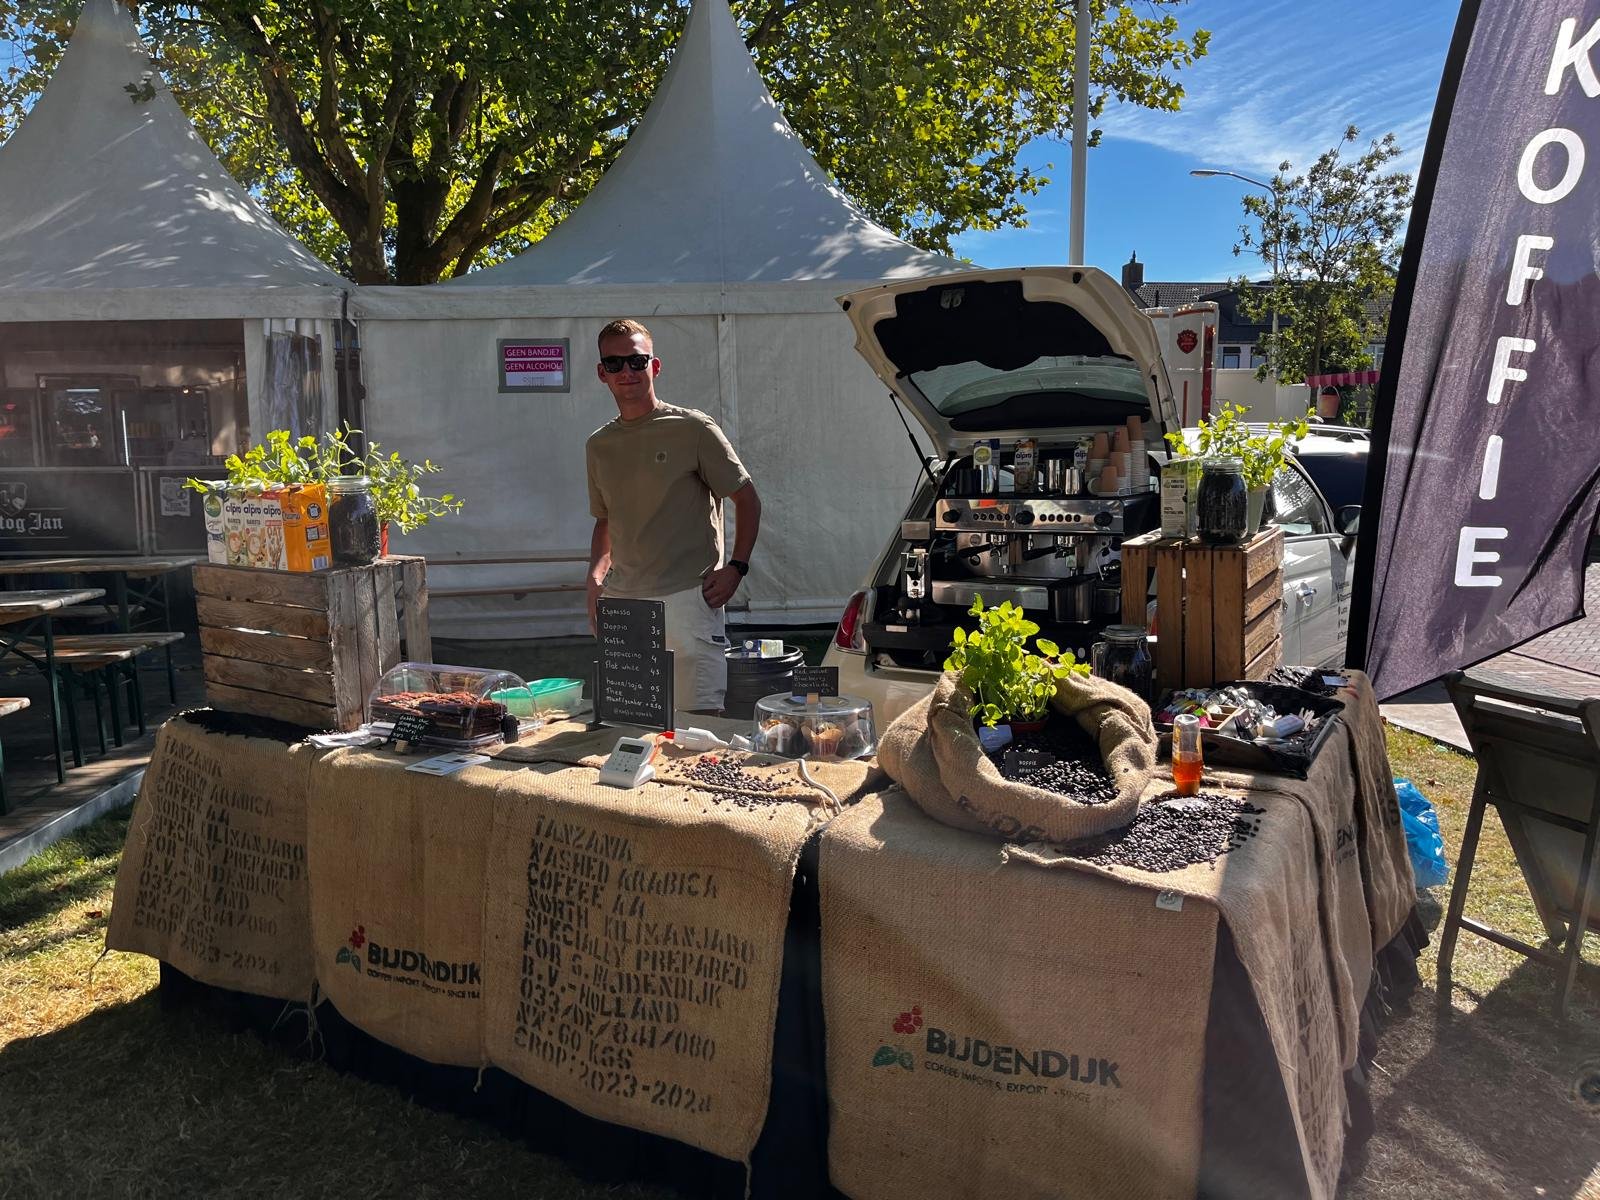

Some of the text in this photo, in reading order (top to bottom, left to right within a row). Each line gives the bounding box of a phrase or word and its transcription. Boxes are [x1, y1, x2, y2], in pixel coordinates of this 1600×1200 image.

[1454, 17, 1600, 588] KOFFIE
[506, 348, 560, 356] GEEN BANDJE?
[1016, 452, 1032, 460] alpro
[226, 502, 242, 516] alpro
[244, 504, 262, 517] alpro
[263, 504, 282, 518] alpro
[28, 512, 64, 536] Jan
[602, 606, 657, 620] Espresso 3
[604, 622, 628, 632] Doppio
[651, 656, 657, 664] 4
[652, 694, 657, 702] 3
[534, 814, 632, 863] TANZANIA
[528, 862, 646, 920] COFFEE AA
[618, 868, 719, 899] ARABICA
[528, 886, 756, 963] NORTH KILIMANJARO
[523, 930, 562, 968] FOR
[635, 948, 749, 990] PREPARED
[926, 1027, 1124, 1088] BIJDENDIJK
[924, 1060, 960, 1079] COFFEE
[1006, 1082, 1049, 1096] EXPORT
